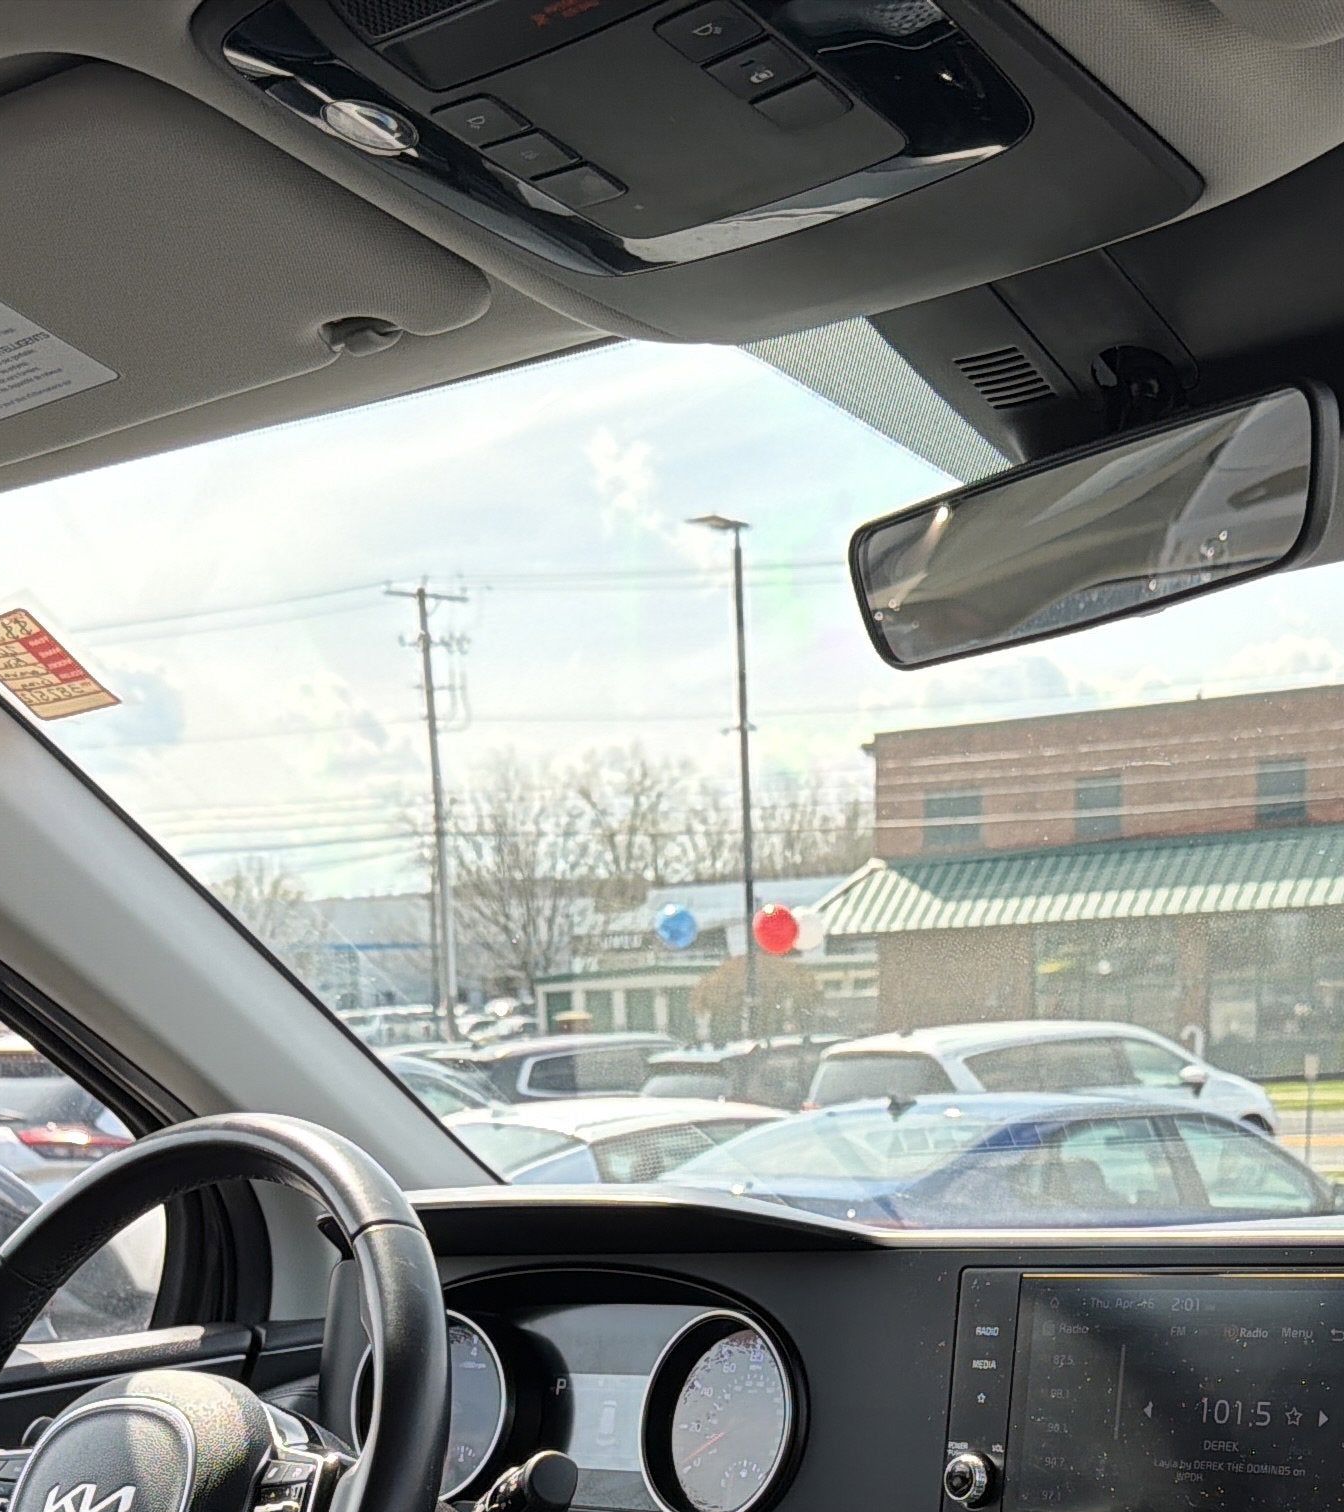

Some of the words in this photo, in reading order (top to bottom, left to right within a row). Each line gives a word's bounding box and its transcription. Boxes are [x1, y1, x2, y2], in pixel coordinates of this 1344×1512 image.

[1171, 1297, 1200, 1312] 2:01
[975, 1326, 999, 1337] RADIO
[1059, 1323, 1088, 1335] Radio
[1170, 1326, 1186, 1336] FM
[1239, 1327, 1269, 1338] Radio
[1281, 1326, 1313, 1339] Menu
[722, 1361, 737, 1374] 60
[972, 1359, 997, 1370] MEDIA
[556, 1378, 567, 1396] P
[1201, 1399, 1271, 1427] 101.5
[688, 1421, 702, 1433] 20
[947, 1441, 969, 1450] POWER
[992, 1443, 1005, 1454] VOL
[1204, 1440, 1239, 1452] DEREK
[1180, 1459, 1192, 1470] by
[1193, 1461, 1224, 1472] DEREK
[1226, 1462, 1245, 1473] THE
[1292, 1468, 1306, 1477] on
